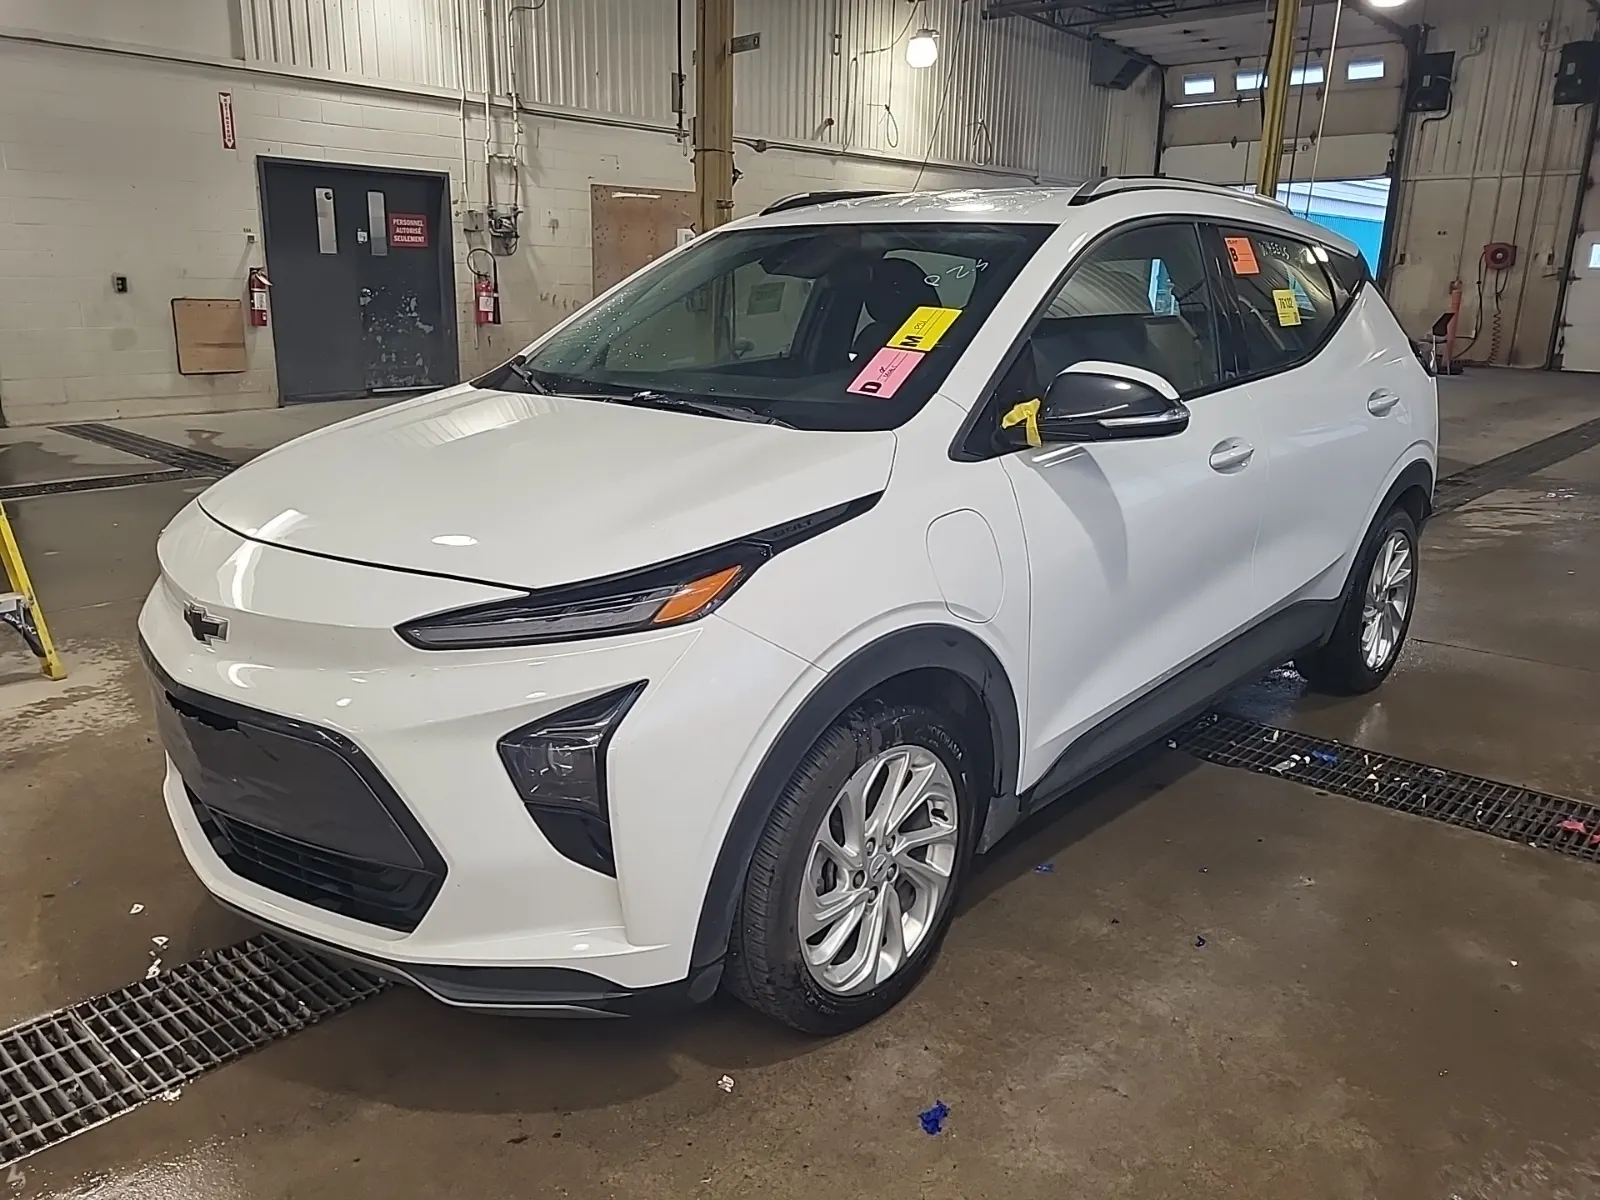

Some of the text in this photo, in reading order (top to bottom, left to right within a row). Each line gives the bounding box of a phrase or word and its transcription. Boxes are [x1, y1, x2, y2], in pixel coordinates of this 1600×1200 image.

[392, 218, 425, 227] PERSONNEL
[395, 227, 422, 235] AUTORISÉ
[393, 235, 425, 243] SEULEMENT
[1229, 247, 1239, 262] B
[899, 335, 924, 347] M
[858, 381, 882, 394] D
[772, 519, 813, 538] BOLT
[927, 723, 964, 761] YOKOHAMA
